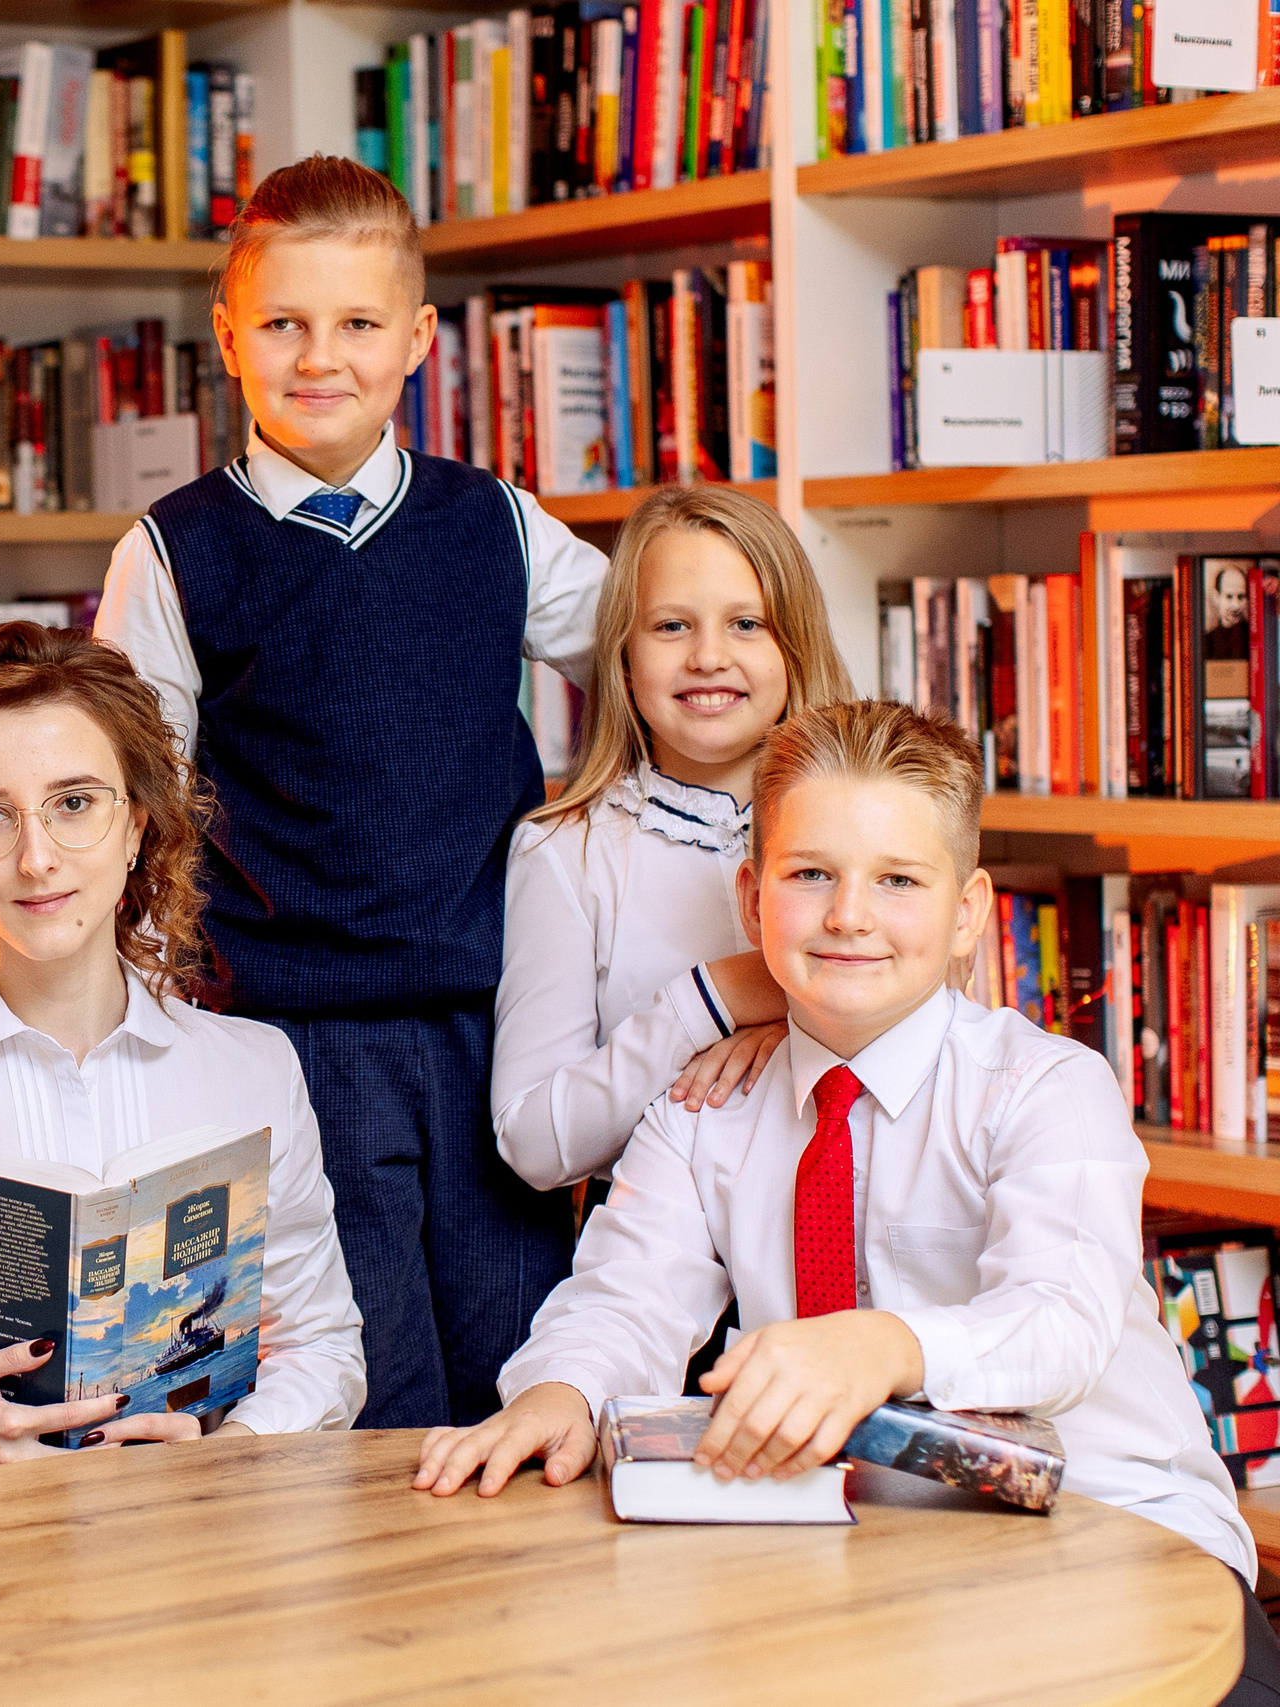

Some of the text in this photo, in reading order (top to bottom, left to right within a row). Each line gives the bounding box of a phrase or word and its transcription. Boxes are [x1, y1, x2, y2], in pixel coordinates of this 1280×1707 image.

[188, 1200, 210, 1214] Жорж
[183, 1208, 213, 1224] Сименон
[174, 1227, 220, 1252] ПАССАЖИР
[89, 1264, 120, 1276] ПАССАЖИР
